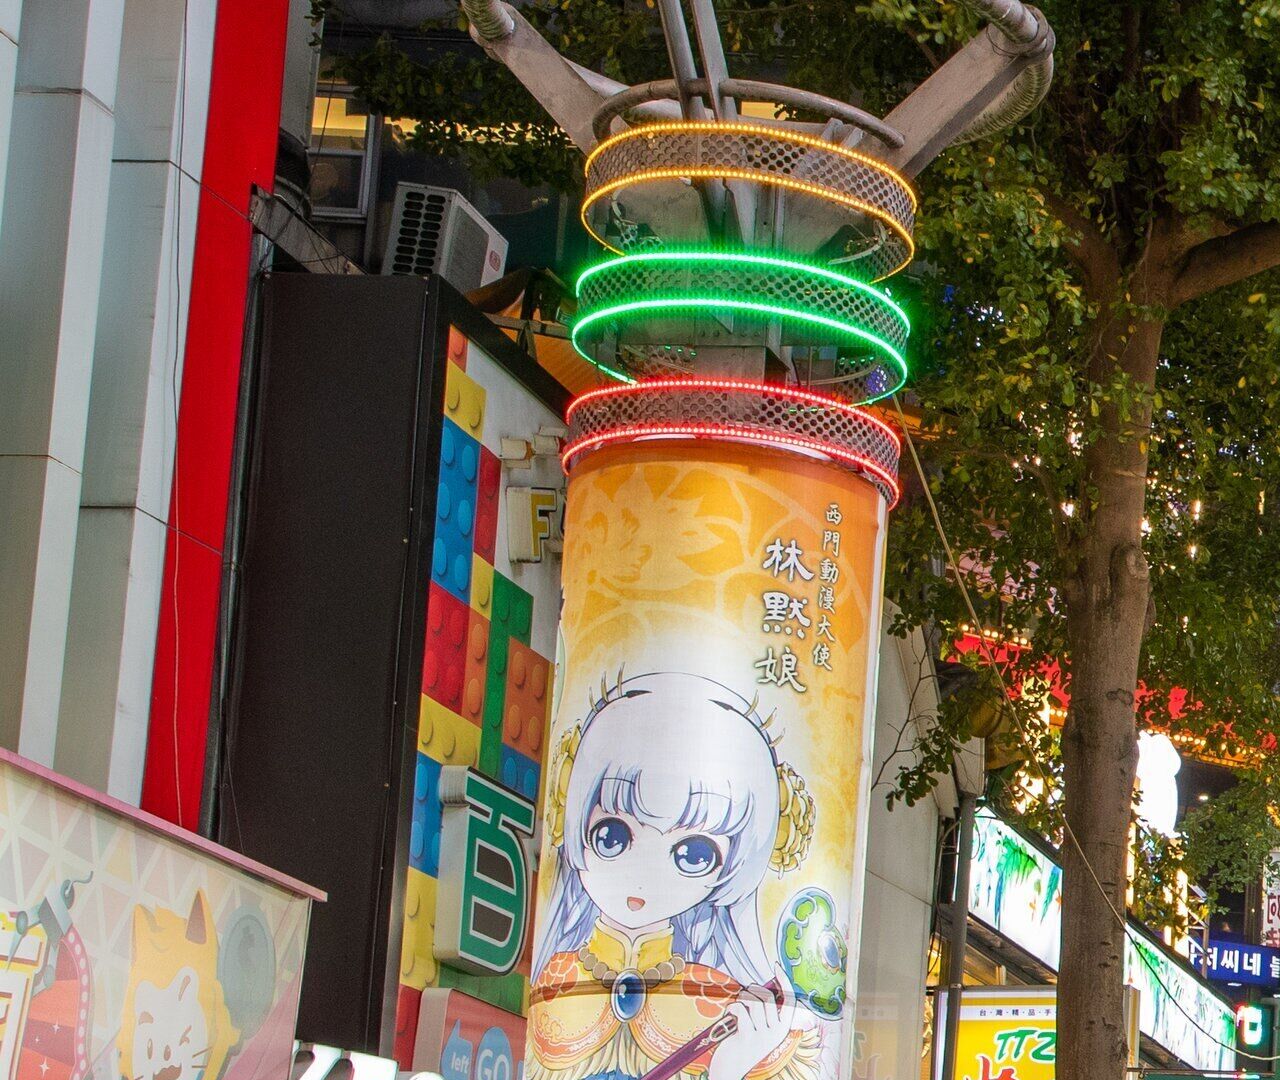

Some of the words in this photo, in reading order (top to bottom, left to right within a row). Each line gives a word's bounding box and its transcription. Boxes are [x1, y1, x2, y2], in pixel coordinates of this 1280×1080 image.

[812, 503, 844, 671] 西門動漫大使
[451, 1059, 469, 1075] left
